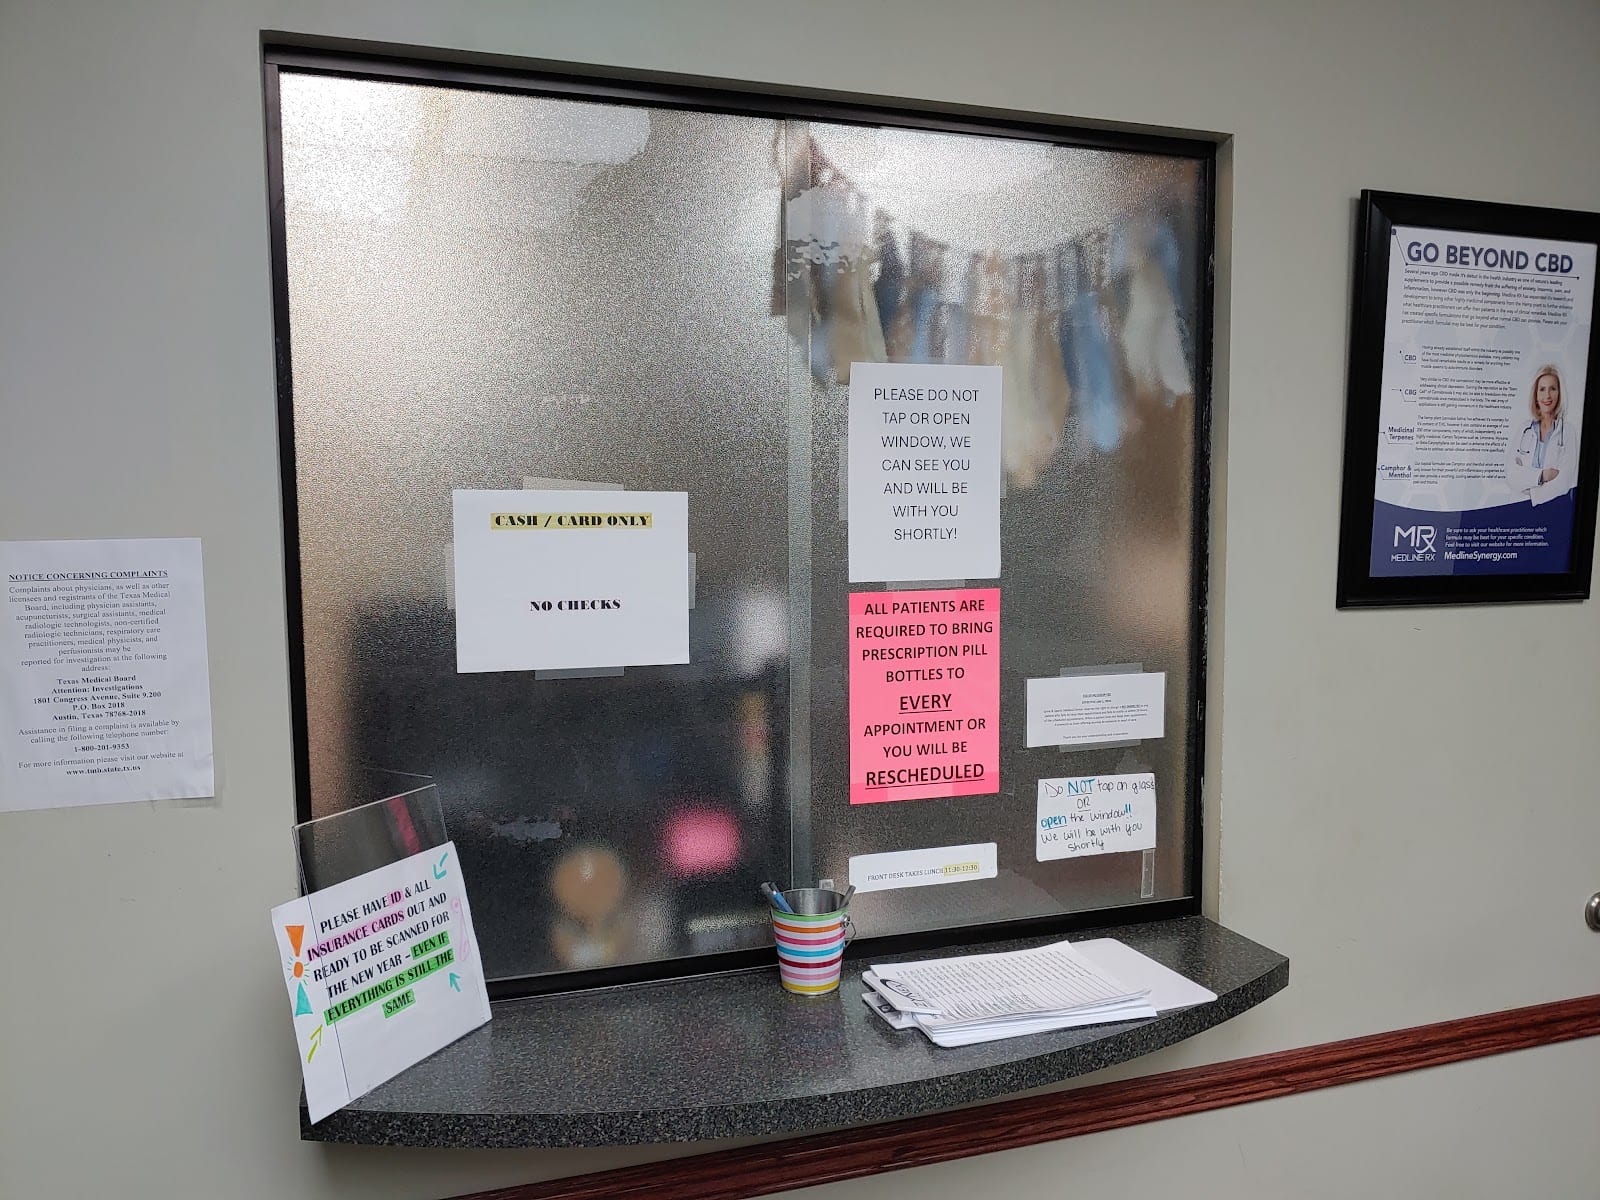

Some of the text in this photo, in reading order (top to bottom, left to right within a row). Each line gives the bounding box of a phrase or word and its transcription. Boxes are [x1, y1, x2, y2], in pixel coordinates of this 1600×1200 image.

[1407, 241, 1572, 273] GO BEYOND CBD
[874, 388, 978, 401] PLEASE DO NOT
[882, 412, 969, 424] TAP OR OPEN
[881, 436, 971, 449] WINDOW, WE
[882, 459, 969, 470] CAN SEE YOU
[884, 483, 968, 494] AND WILL BE
[893, 506, 958, 517] WITH YOU
[495, 516, 649, 527] CASH / CARD ONLY
[894, 528, 957, 540] SHORTLY!
[1444, 551, 1517, 561] MedlineSynergy.com
[47, 572, 107, 580] CONCERNING
[110, 570, 168, 578] COMPLAINTS
[9, 586, 50, 594] Complaints
[75, 584, 114, 593] physicians,
[59, 593, 95, 602] registrants
[530, 599, 621, 611] NO CHECKS
[865, 600, 985, 615] ALL PATIENTS ARE
[16, 613, 70, 621] acupuncturists,
[856, 622, 993, 639] REQUIRED TO BRING
[862, 644, 987, 660] PRESCRIPTION PILL
[886, 668, 964, 682] BOTTLES TO
[900, 694, 952, 711] EVERY
[864, 718, 986, 736] APPOINTMENT OR
[74, 743, 129, 752] 1-800-201-9353
[883, 742, 967, 758] YOU WILL BE
[866, 764, 984, 786] RESCHEDULED
[1045, 777, 1155, 797] Do NOT tap on glass
[1077, 797, 1090, 809] OR
[1041, 815, 1067, 829] open
[1070, 813, 1084, 822] the
[1041, 823, 1142, 843] We will be with you
[945, 865, 978, 873] 11:30-12:30
[320, 880, 431, 933] PLEASE HAVE ID & ALL
[307, 892, 447, 961] INSURANCE CARDS OUT AND
[314, 911, 450, 981] READY TO BE SCANNED FOR
[326, 979, 349, 998] THE
[351, 967, 374, 987] NEW
[376, 955, 402, 975] YEAR
[412, 938, 434, 957] EVEN
[435, 934, 448, 949] IF
[327, 952, 453, 1021] EVERYTHING IS STILL THE
[385, 993, 413, 1013] SAME
